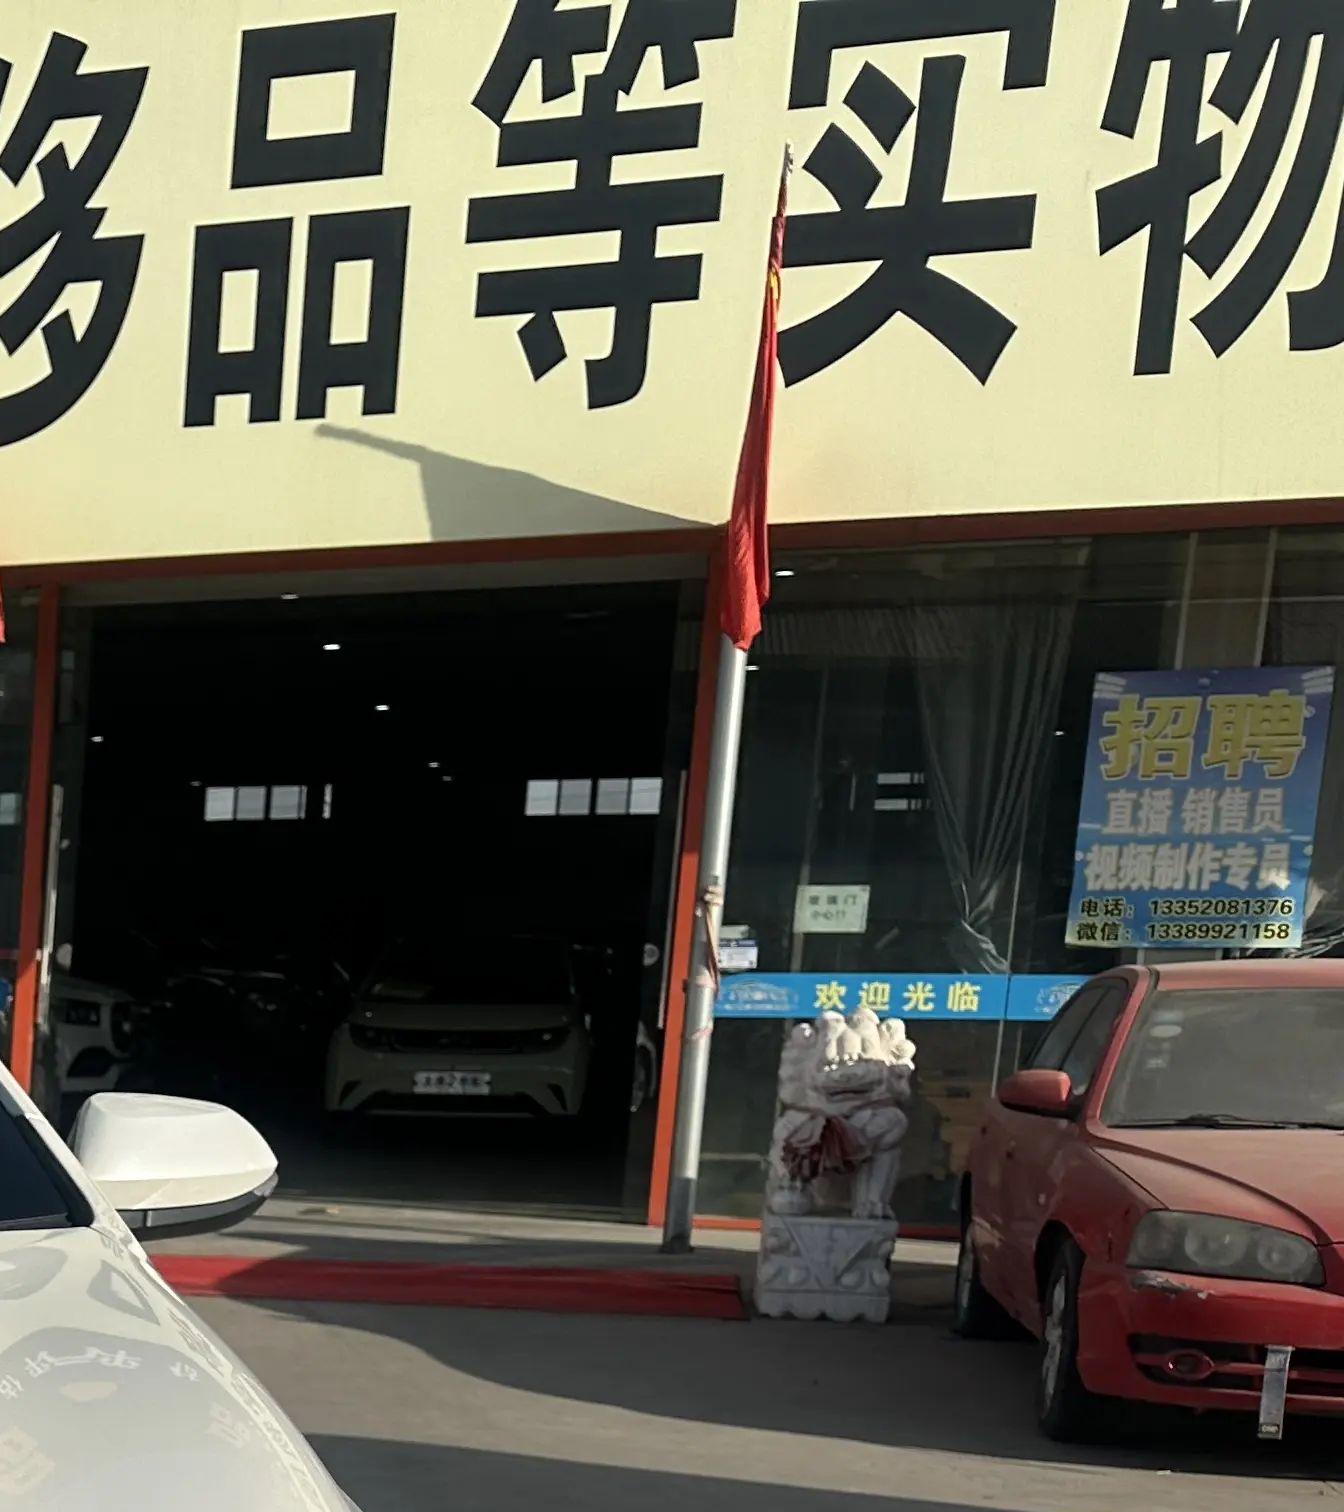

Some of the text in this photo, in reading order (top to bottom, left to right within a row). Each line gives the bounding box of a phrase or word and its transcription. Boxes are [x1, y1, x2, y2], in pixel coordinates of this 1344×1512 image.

[1100, 689, 1307, 780] 招聘
[1102, 788, 1285, 835] 直播 销售员
[1084, 843, 1291, 891] 视频制作专员
[1149, 898, 1293, 917] 13352081376
[1146, 922, 1290, 940] 13389921158
[814, 980, 982, 1013] 欢迎光临
